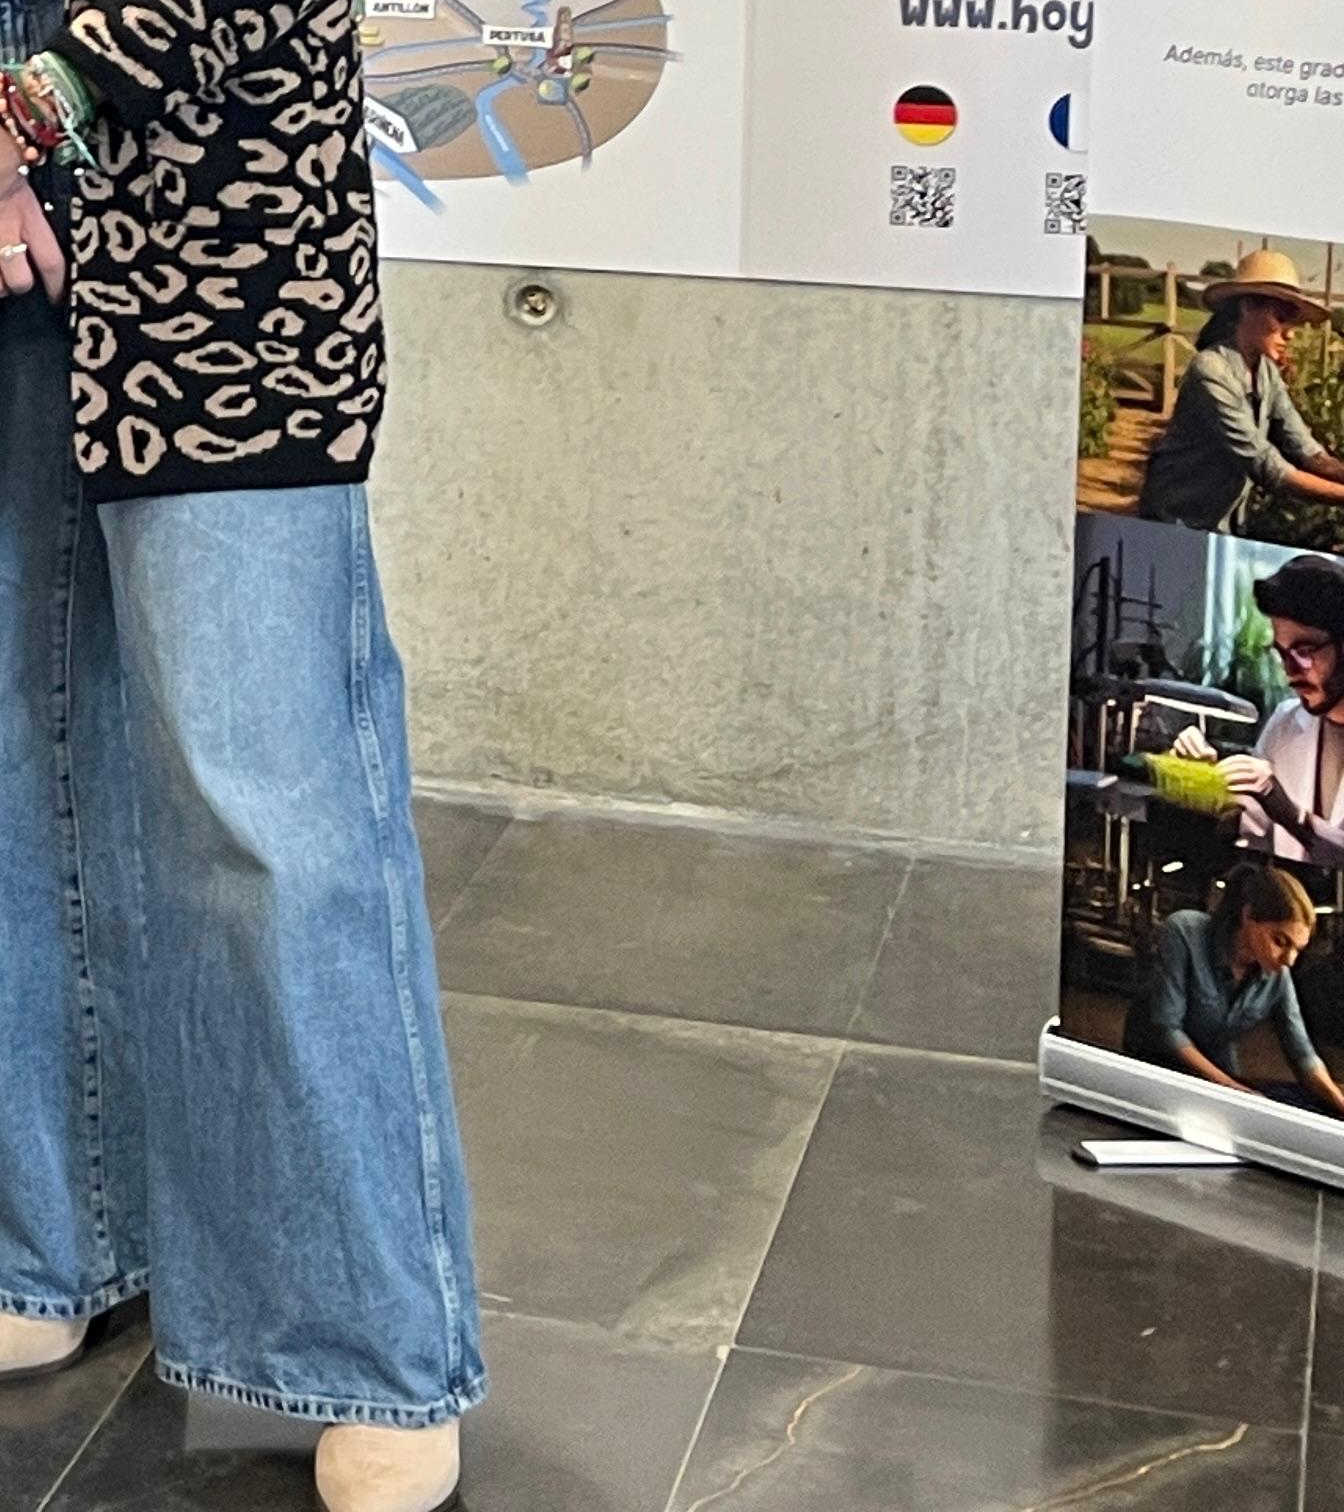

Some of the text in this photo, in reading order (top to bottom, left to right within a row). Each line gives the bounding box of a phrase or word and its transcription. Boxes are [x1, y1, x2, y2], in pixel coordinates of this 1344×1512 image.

[1163, 44, 1248, 73] Además,
[1253, 54, 1294, 76] este
[1246, 80, 1344, 107] otorga las
